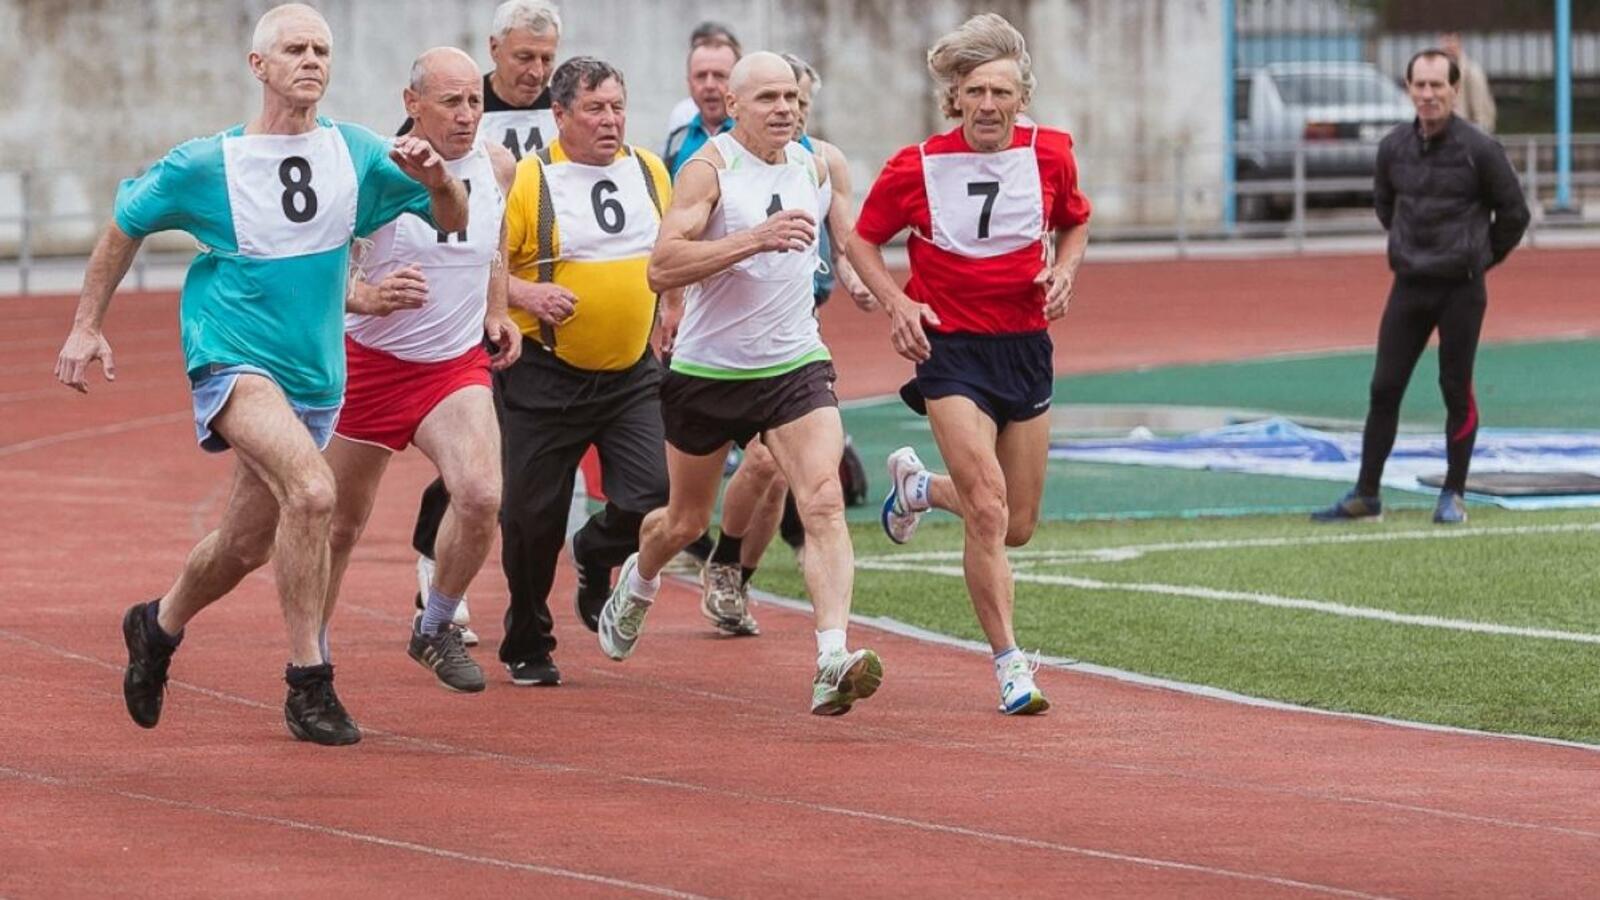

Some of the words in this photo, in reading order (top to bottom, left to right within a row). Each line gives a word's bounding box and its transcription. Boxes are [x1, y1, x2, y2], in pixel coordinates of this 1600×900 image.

[278, 155, 318, 223] 8
[591, 179, 626, 234] 6
[967, 181, 1000, 239] 7
